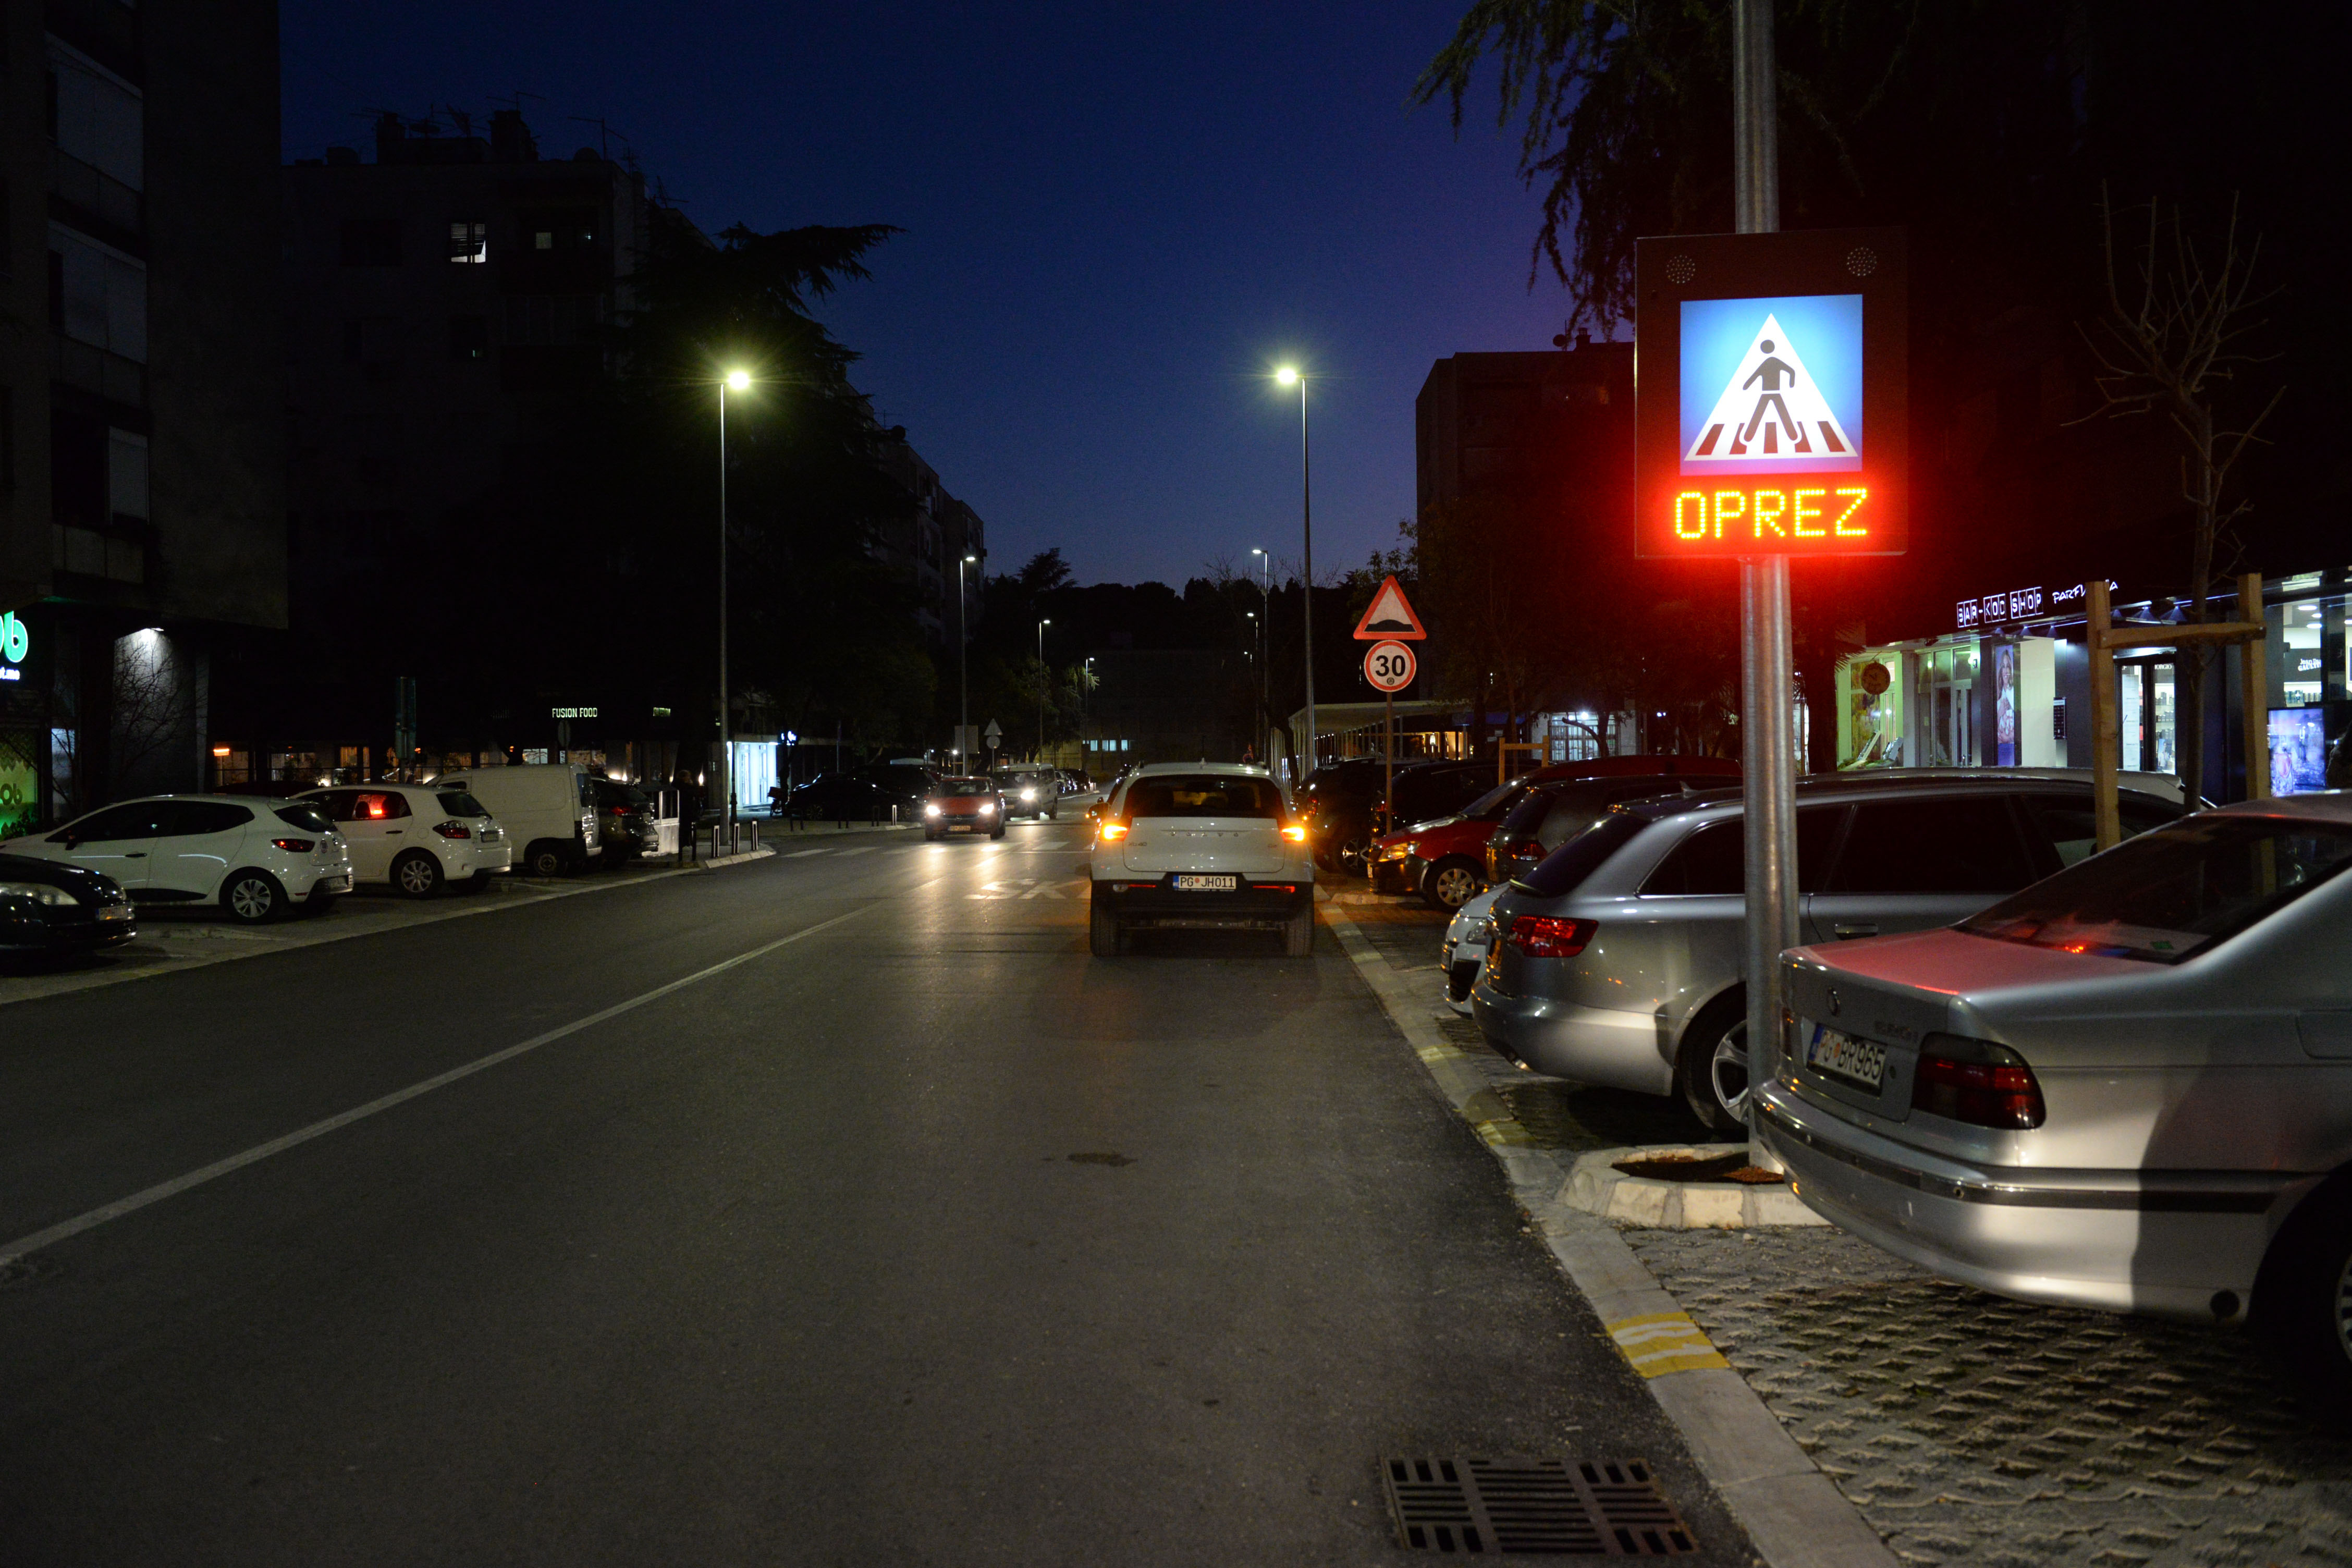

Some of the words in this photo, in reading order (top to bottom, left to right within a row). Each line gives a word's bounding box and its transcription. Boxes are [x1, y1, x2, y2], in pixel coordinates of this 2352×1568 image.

[1675, 487, 1868, 540] OPREZ
[2011, 590, 2042, 616] SHOP
[1375, 655, 1406, 677] 30
[552, 708, 578, 718] FUSION
[579, 707, 598, 718] FOOD
[1180, 877, 1194, 887] PG
[1200, 877, 1235, 888] JH011
[1838, 1037, 1885, 1080] BR965
